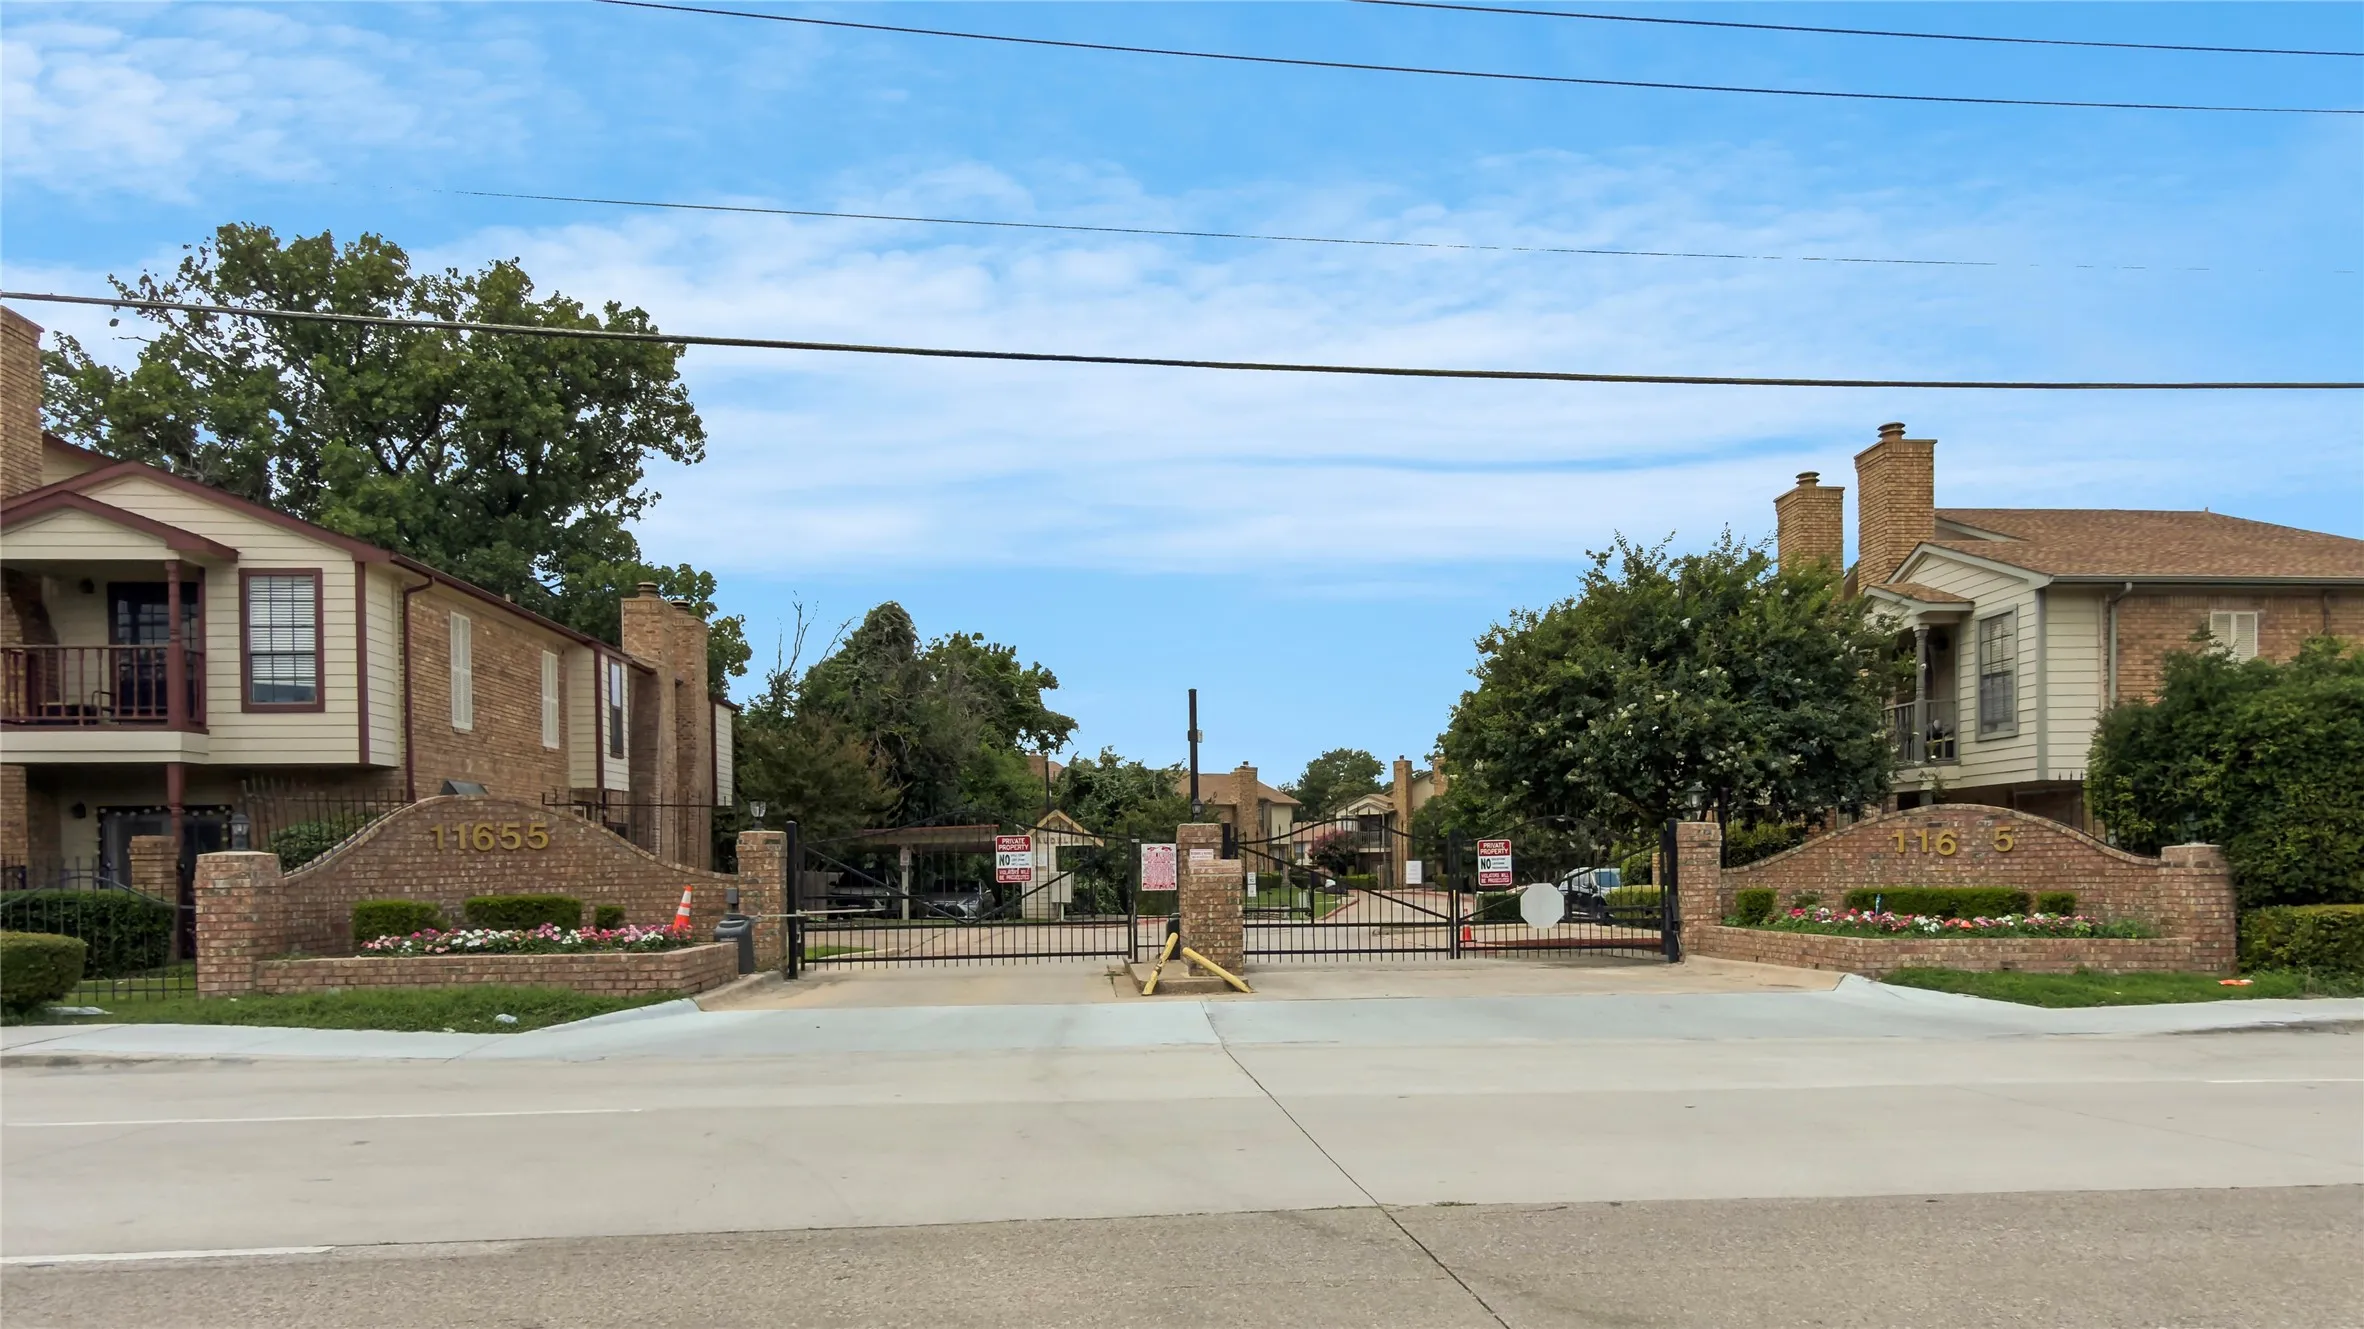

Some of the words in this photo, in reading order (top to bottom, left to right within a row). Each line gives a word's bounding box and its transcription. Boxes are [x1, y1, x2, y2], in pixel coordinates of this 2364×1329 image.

[430, 821, 549, 851] 11655
[999, 854, 1010, 866] NO
[1481, 858, 1491, 869] NO
